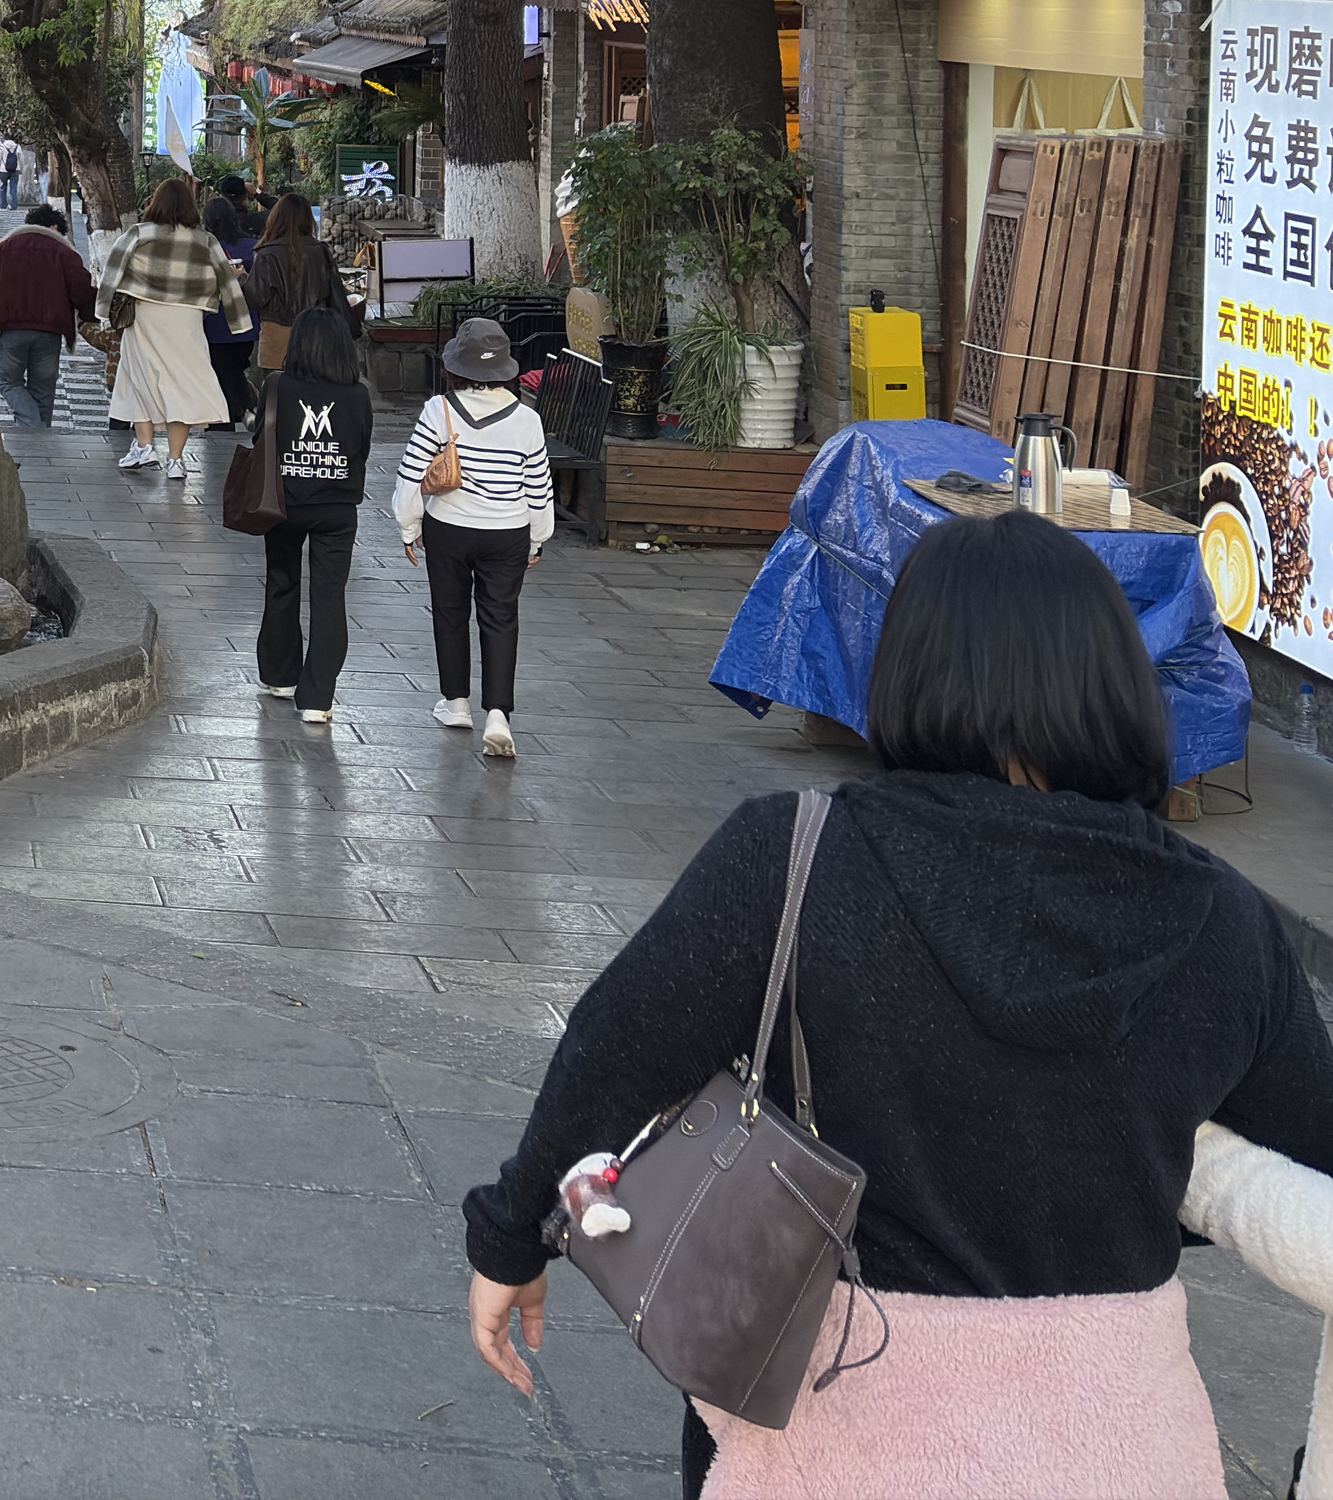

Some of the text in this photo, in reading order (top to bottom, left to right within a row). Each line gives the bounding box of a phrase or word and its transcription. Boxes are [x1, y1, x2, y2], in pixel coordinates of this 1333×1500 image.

[1245, 25, 1333, 100] 现磨
[1214, 29, 1238, 267] 云南小粒咖啡
[1243, 112, 1333, 194] 免费
[1241, 203, 1333, 290] 全国
[1218, 299, 1331, 371] 云南咖啡还
[283, 452, 348, 467] CLOTHING
[291, 440, 340, 453] UNIQUE
